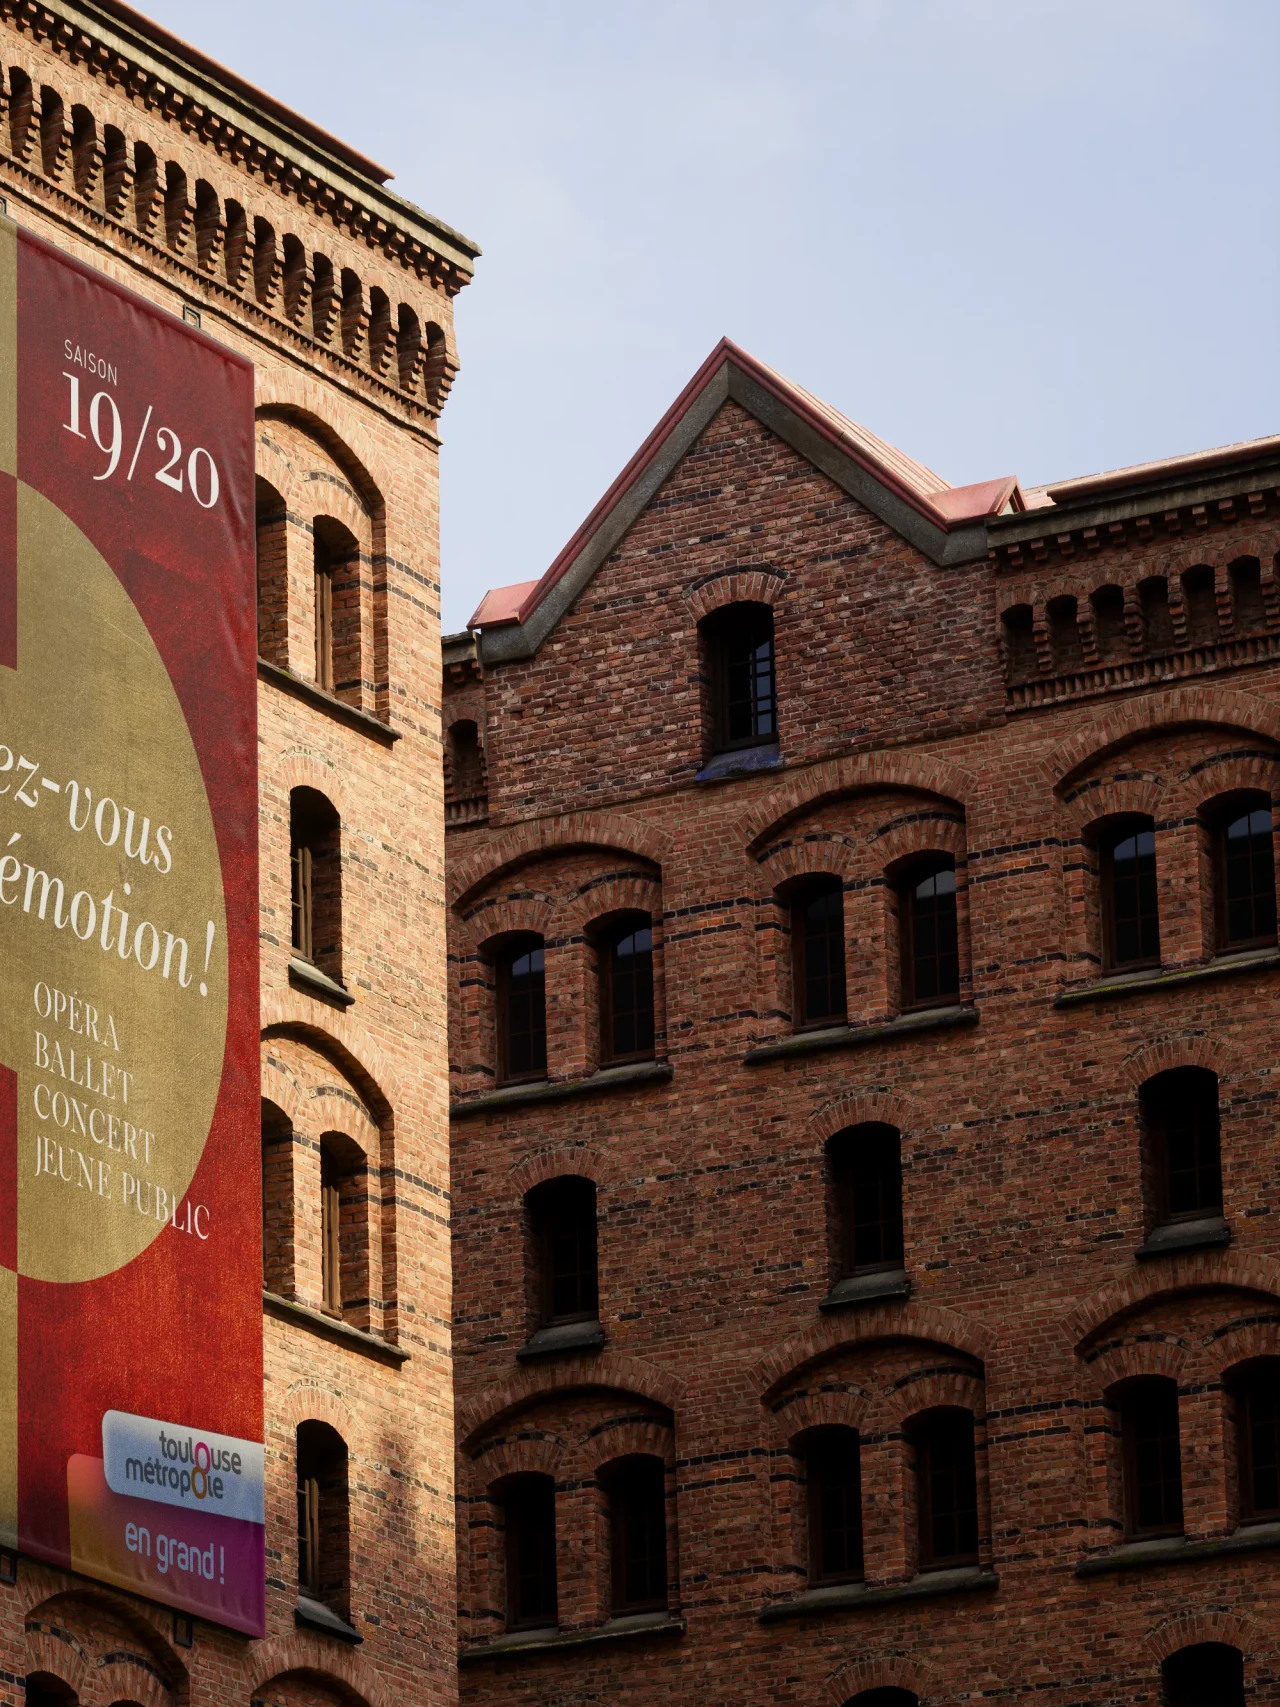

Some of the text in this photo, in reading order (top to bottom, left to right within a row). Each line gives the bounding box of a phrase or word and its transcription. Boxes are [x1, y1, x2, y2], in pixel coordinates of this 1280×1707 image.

[64, 339, 118, 386] SAISON
[62, 371, 220, 509] 19/20
[34, 981, 120, 1051] OPÉRA
[34, 1030, 134, 1105] BALLET
[33, 1084, 156, 1164] CONCERT
[34, 1135, 210, 1240] JEUNE PUBLIC
[158, 1430, 242, 1475] toulouse
[125, 1522, 151, 1557] en
